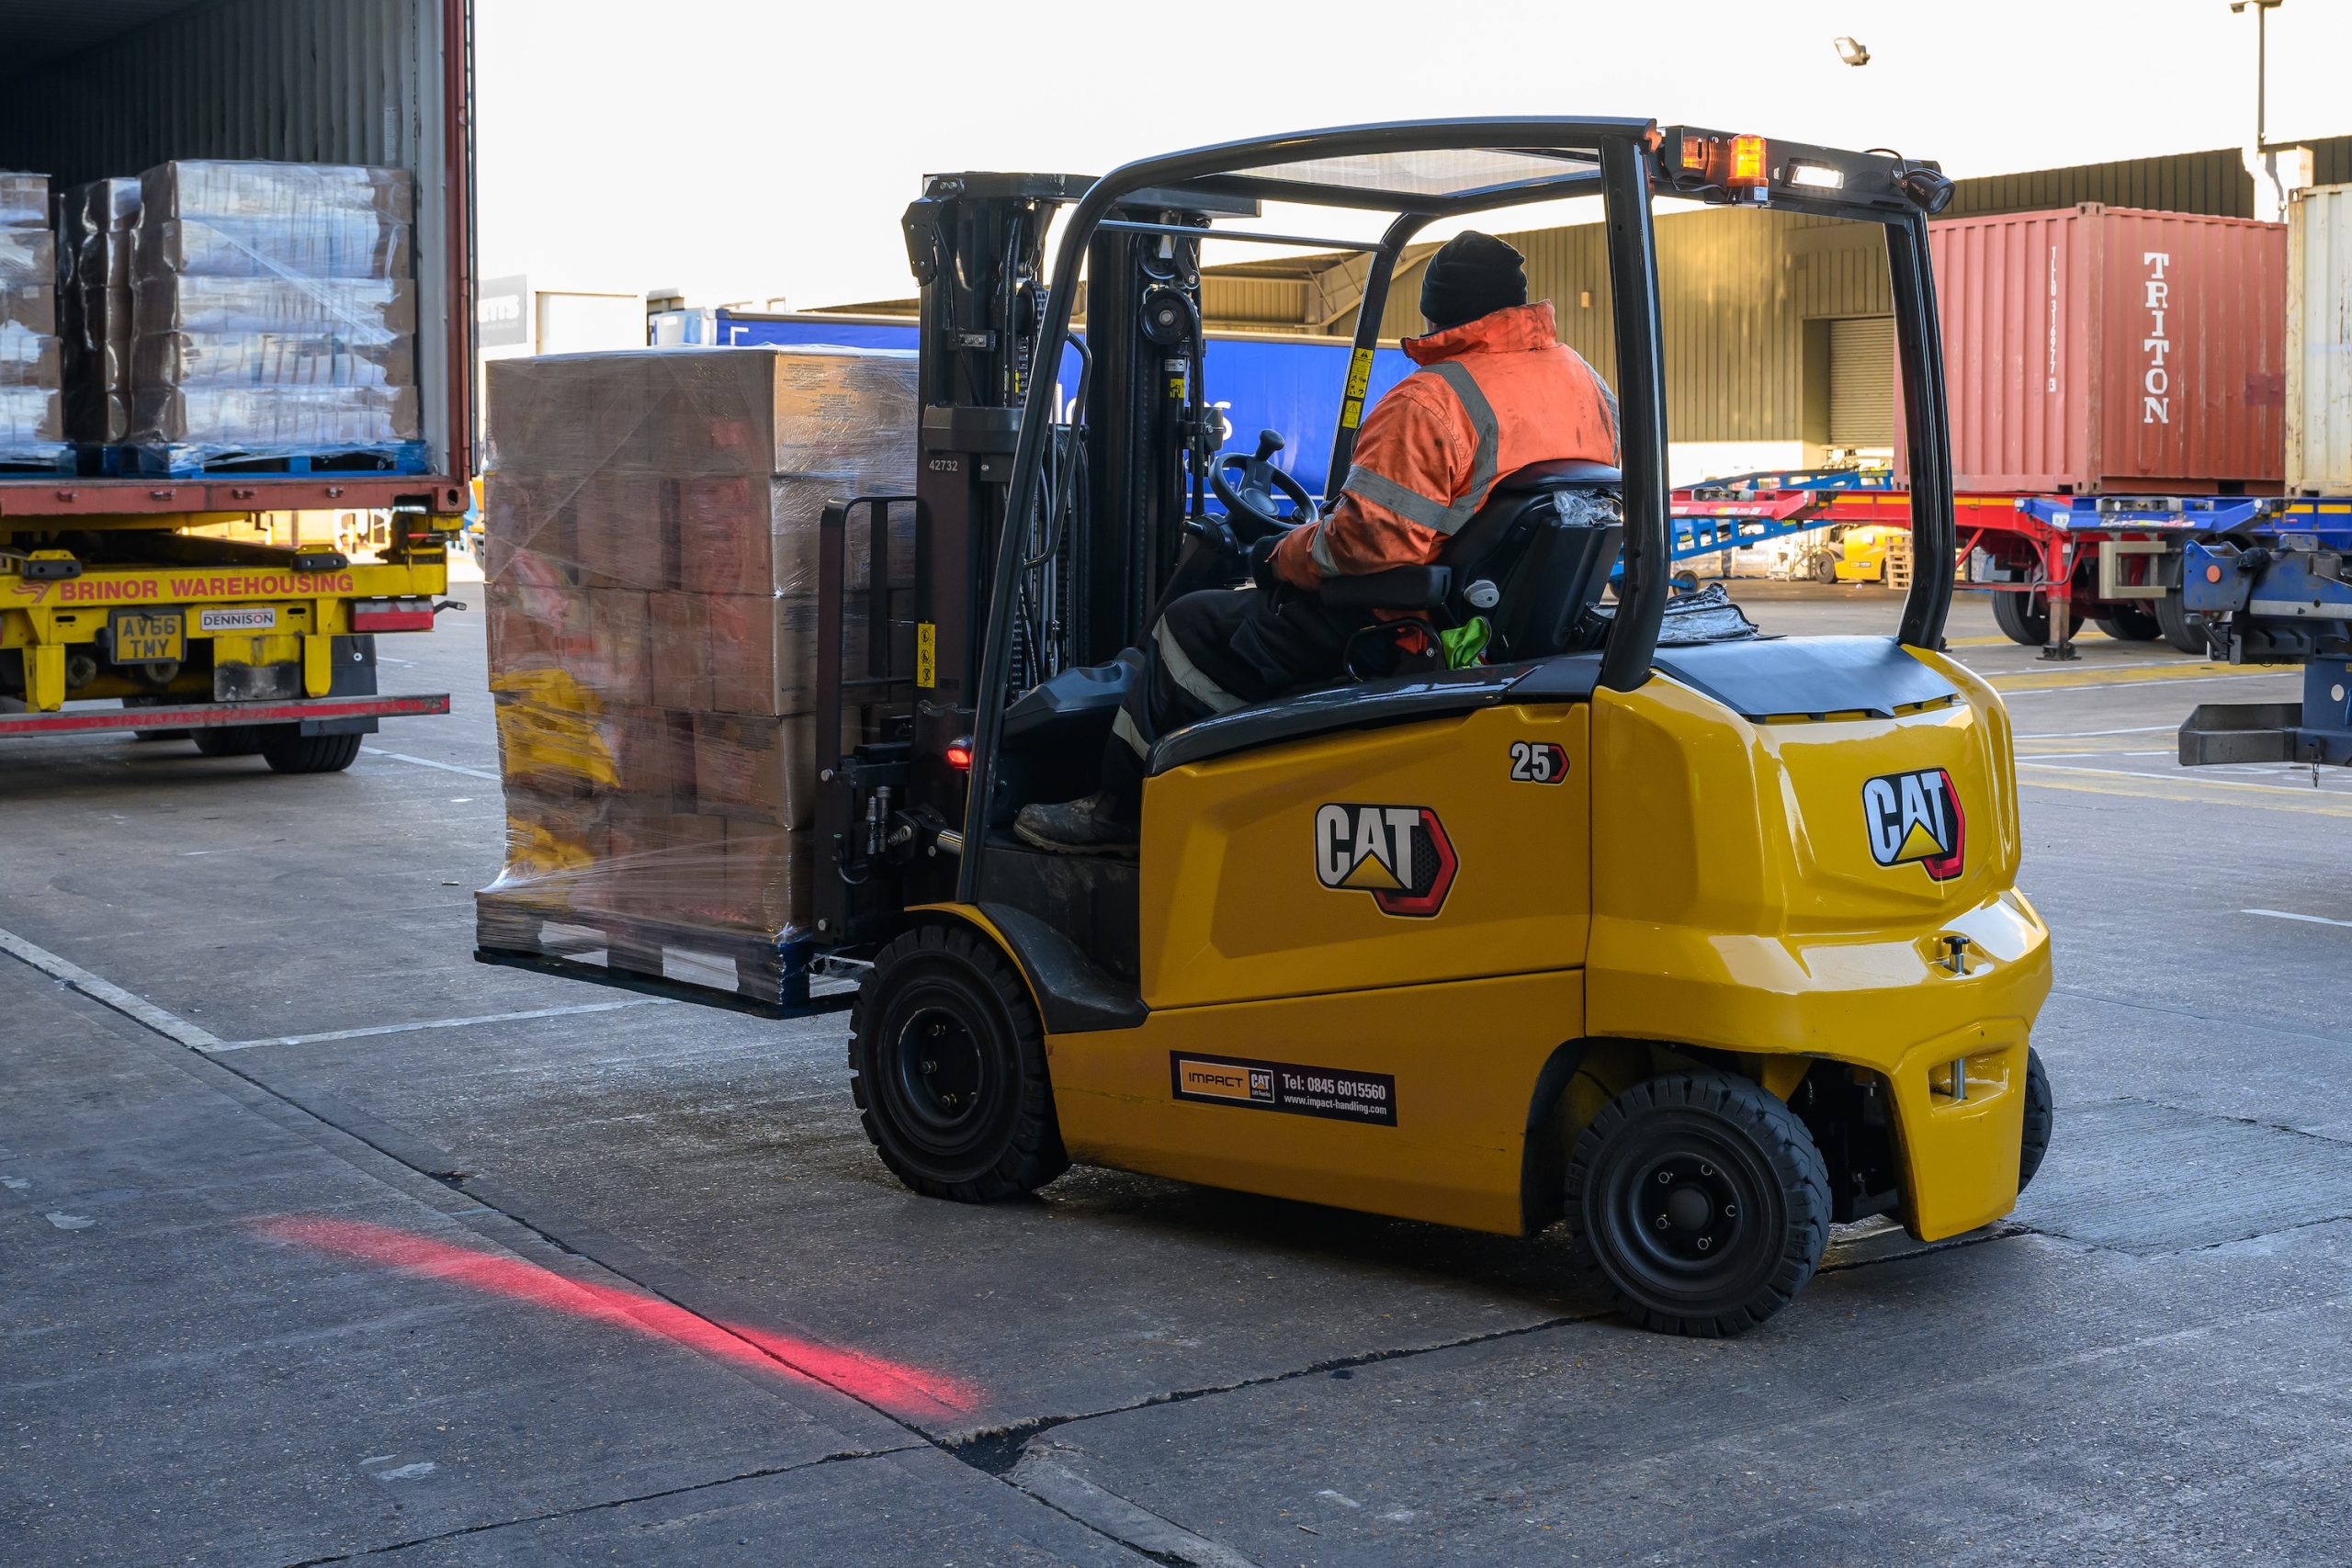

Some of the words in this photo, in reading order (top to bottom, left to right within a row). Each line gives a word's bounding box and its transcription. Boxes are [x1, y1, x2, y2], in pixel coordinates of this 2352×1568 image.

[2143, 252, 2169, 424] TRITON
[929, 460, 957, 470] 42732
[60, 579, 159, 602] BRINOR
[170, 573, 354, 597] WAREHOUSING
[123, 617, 176, 637] AV66
[203, 615, 273, 626] DENNISON
[130, 638, 169, 658] TMY
[1511, 742, 1551, 781] 25
[1865, 772, 1948, 863] CAT
[1317, 805, 1419, 890] CAT
[1189, 1072, 1243, 1089] IMPACT
[1251, 1074, 1270, 1089] CAT
[1283, 1073, 1305, 1091] Tel:
[1307, 1077, 1335, 1094] 0845
[1337, 1082, 1386, 1100] 6015560
[1283, 1094, 1387, 1115] www.impact-handling.com
